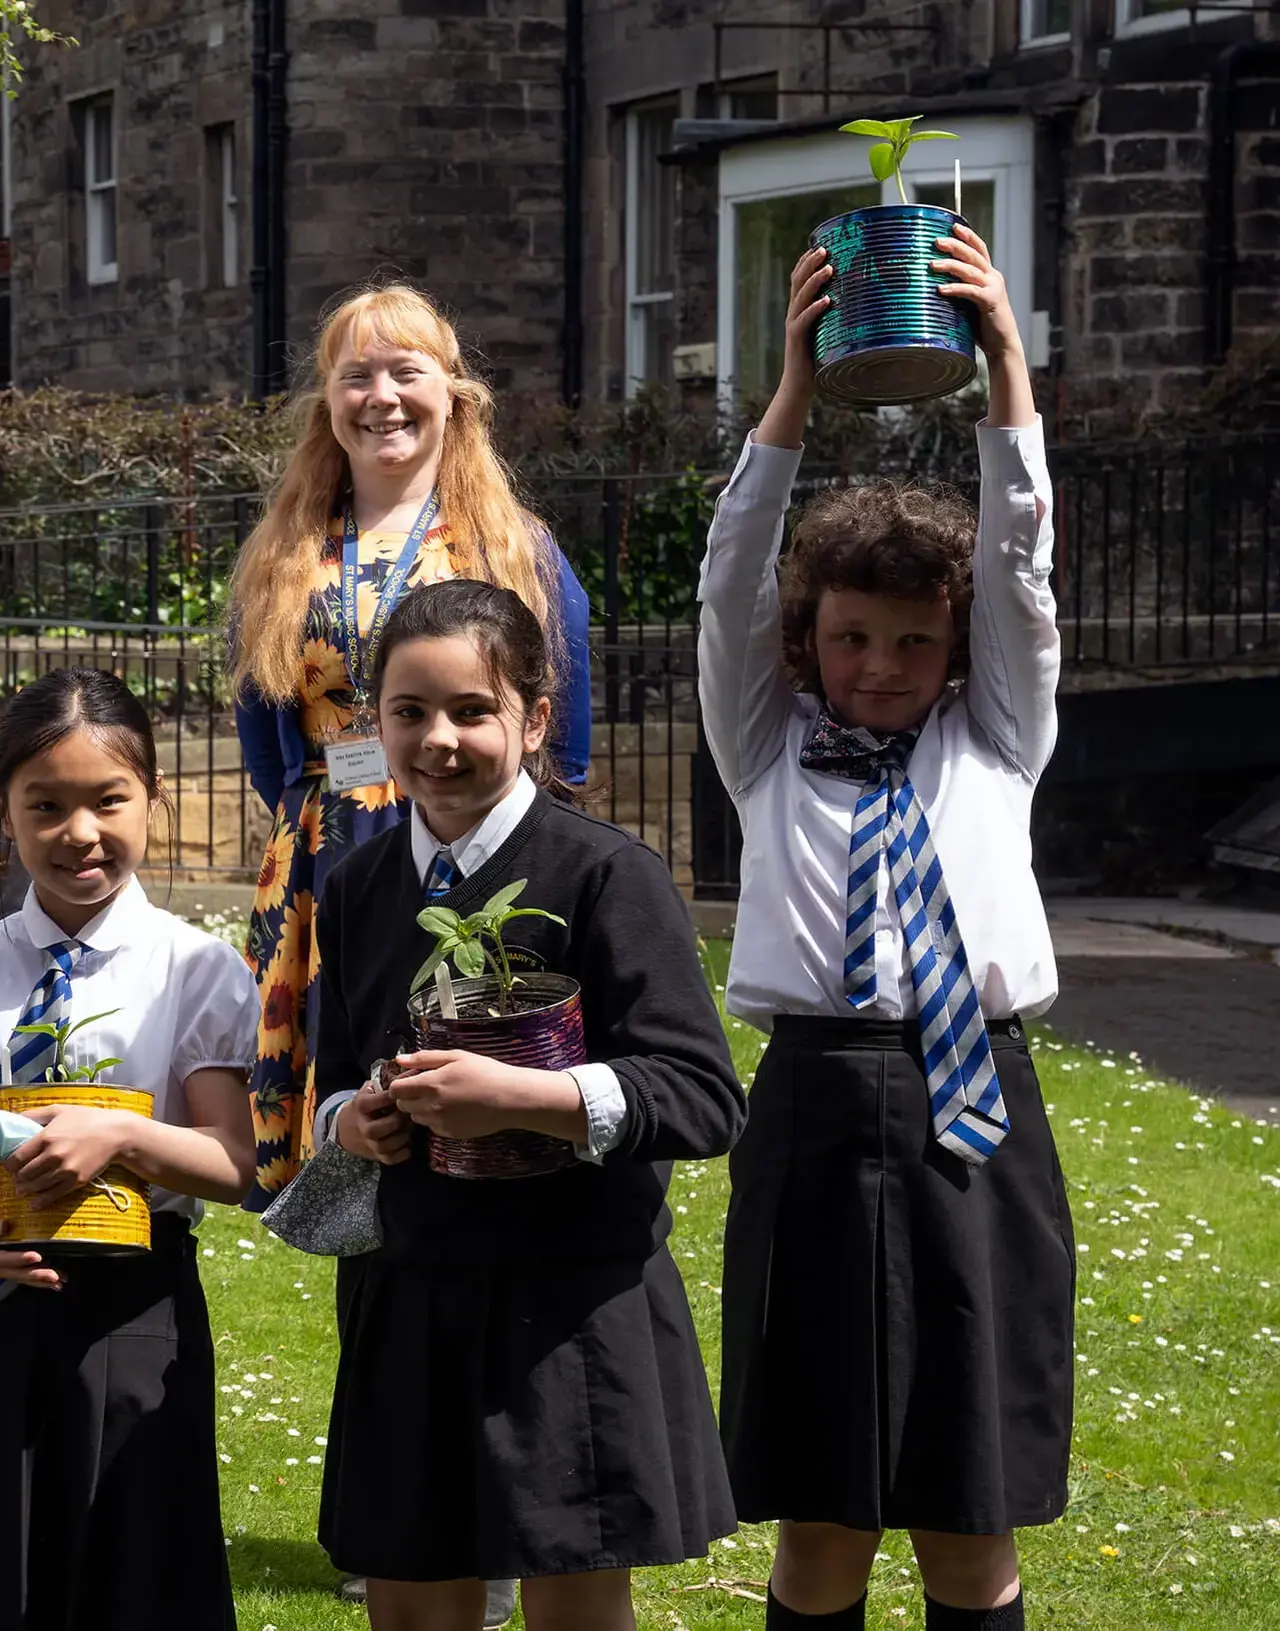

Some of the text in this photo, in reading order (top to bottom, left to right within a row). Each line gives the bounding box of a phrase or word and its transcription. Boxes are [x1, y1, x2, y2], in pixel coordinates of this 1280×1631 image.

[411, 529, 423, 541] ST
[345, 564, 355, 575] ST
[345, 576, 355, 606] MARY'S
[375, 599, 391, 627] MUSIC
[385, 567, 406, 599] SCHOOL
[345, 606, 356, 637] MUSIC
